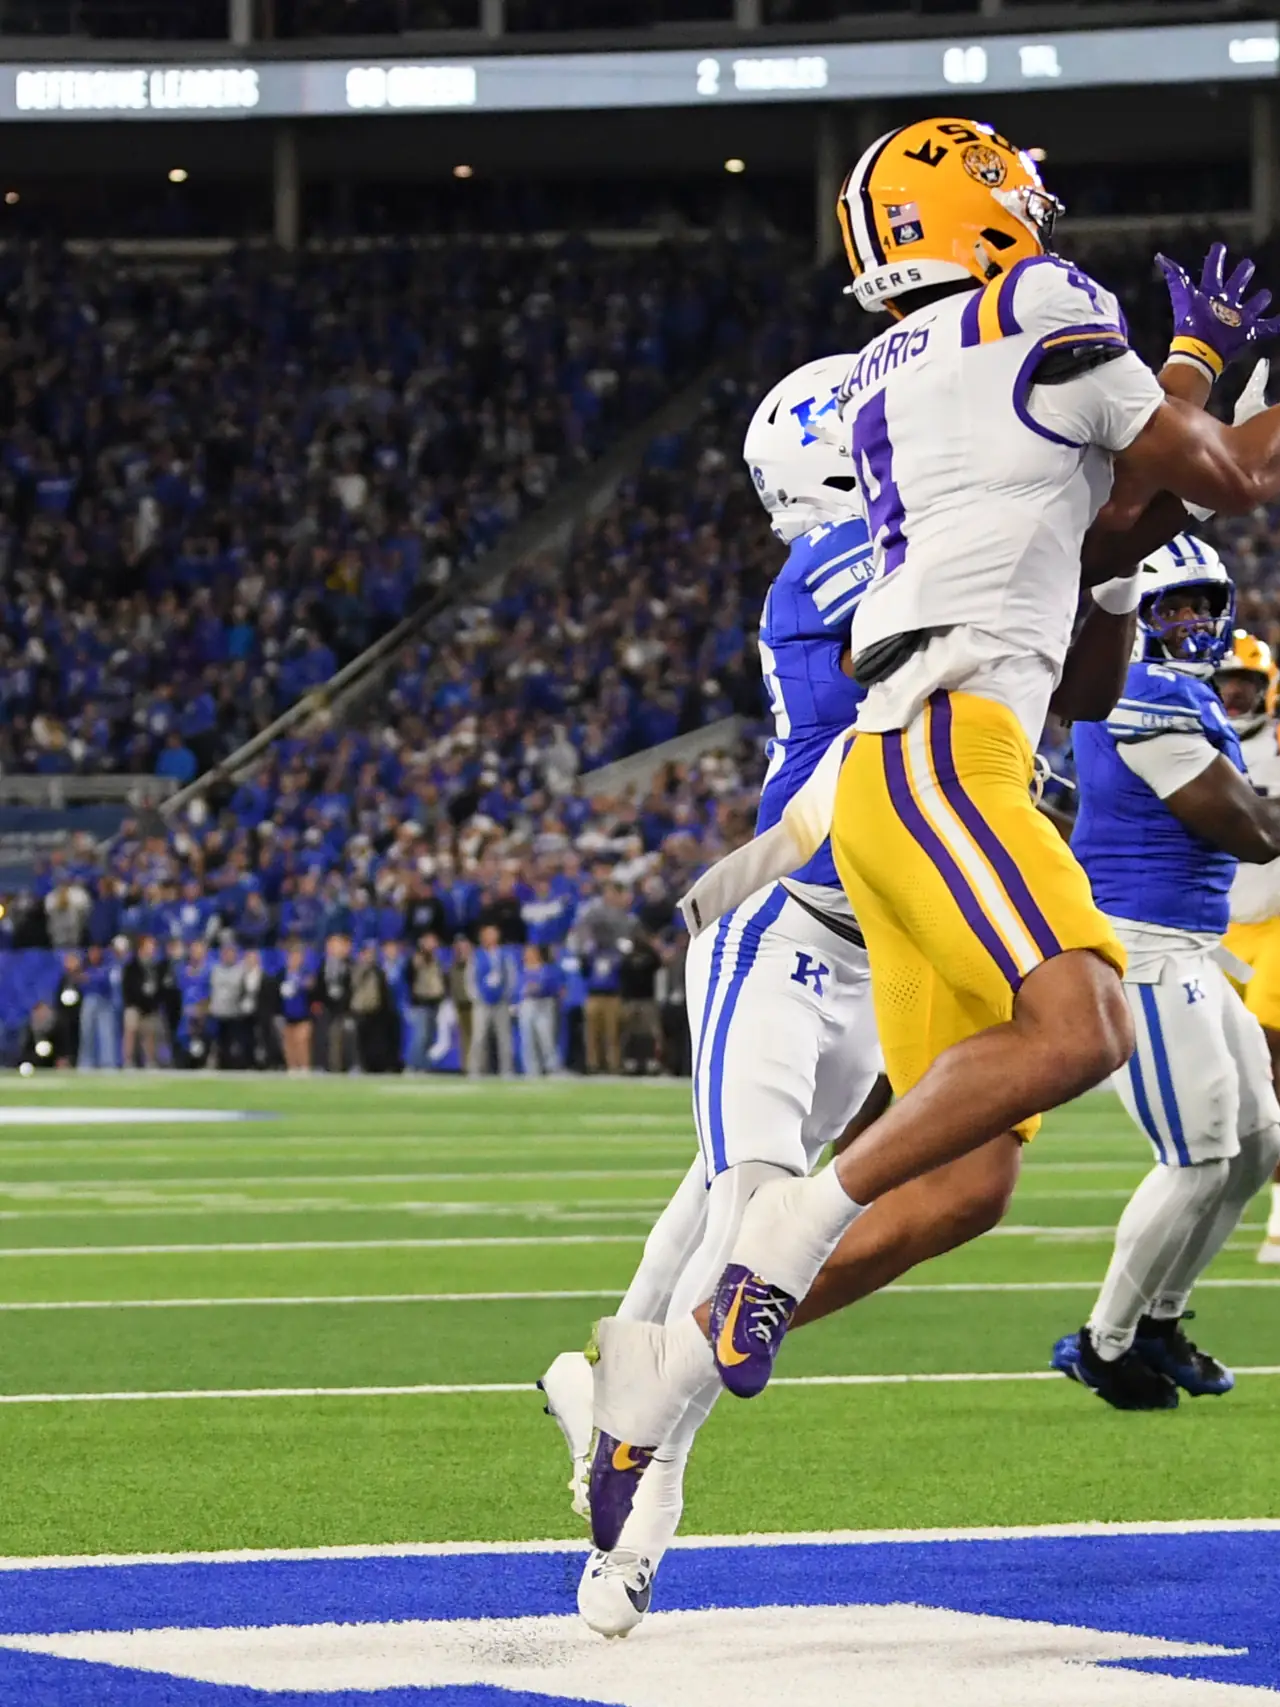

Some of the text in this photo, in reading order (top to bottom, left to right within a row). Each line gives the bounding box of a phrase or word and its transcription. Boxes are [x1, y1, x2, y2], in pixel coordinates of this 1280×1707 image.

[854, 268, 922, 298] TIGERS
[842, 327, 930, 400] ARRIS
[852, 387, 908, 578] 4
[850, 557, 876, 582] CA
[790, 950, 830, 998] K
[1182, 979, 1206, 1005] K
